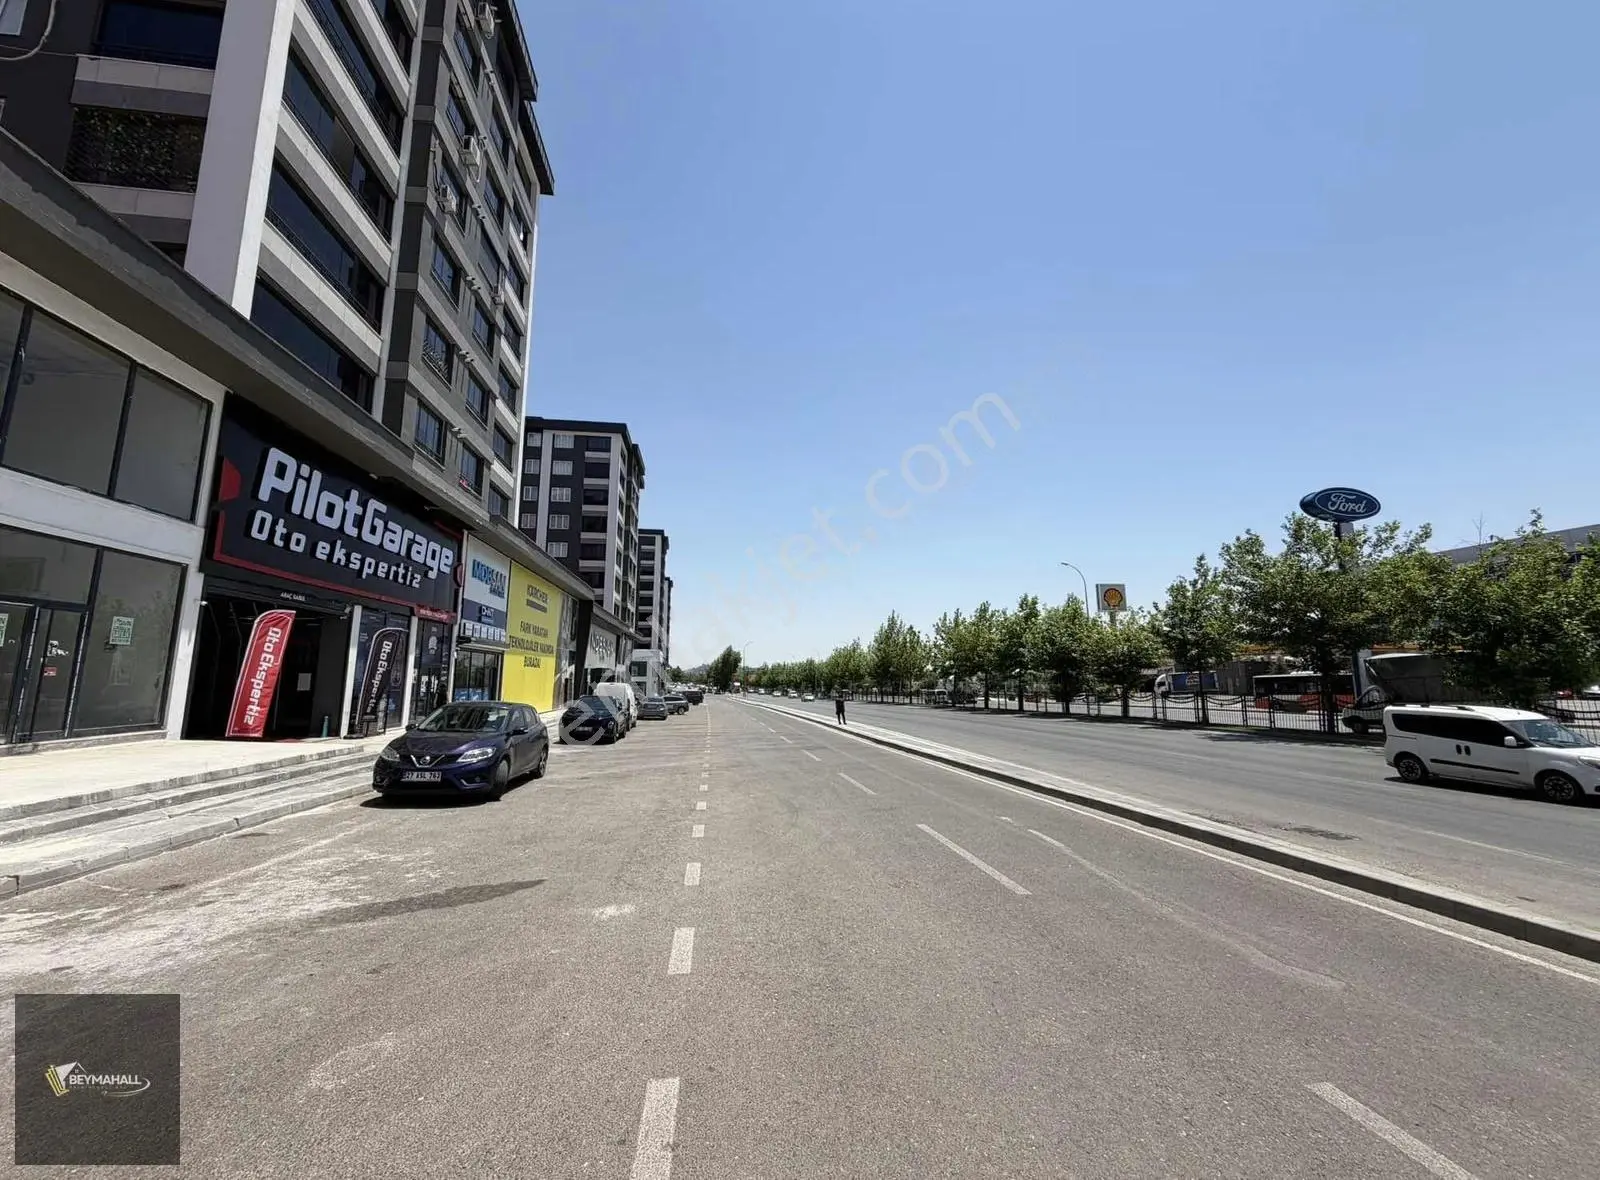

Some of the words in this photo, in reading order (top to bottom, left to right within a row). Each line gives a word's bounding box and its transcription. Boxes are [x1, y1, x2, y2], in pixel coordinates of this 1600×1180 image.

[258, 447, 454, 579] PilotGarage
[1328, 493, 1367, 513] Ford
[251, 509, 306, 553] Oto
[315, 540, 422, 588] ekspertiz
